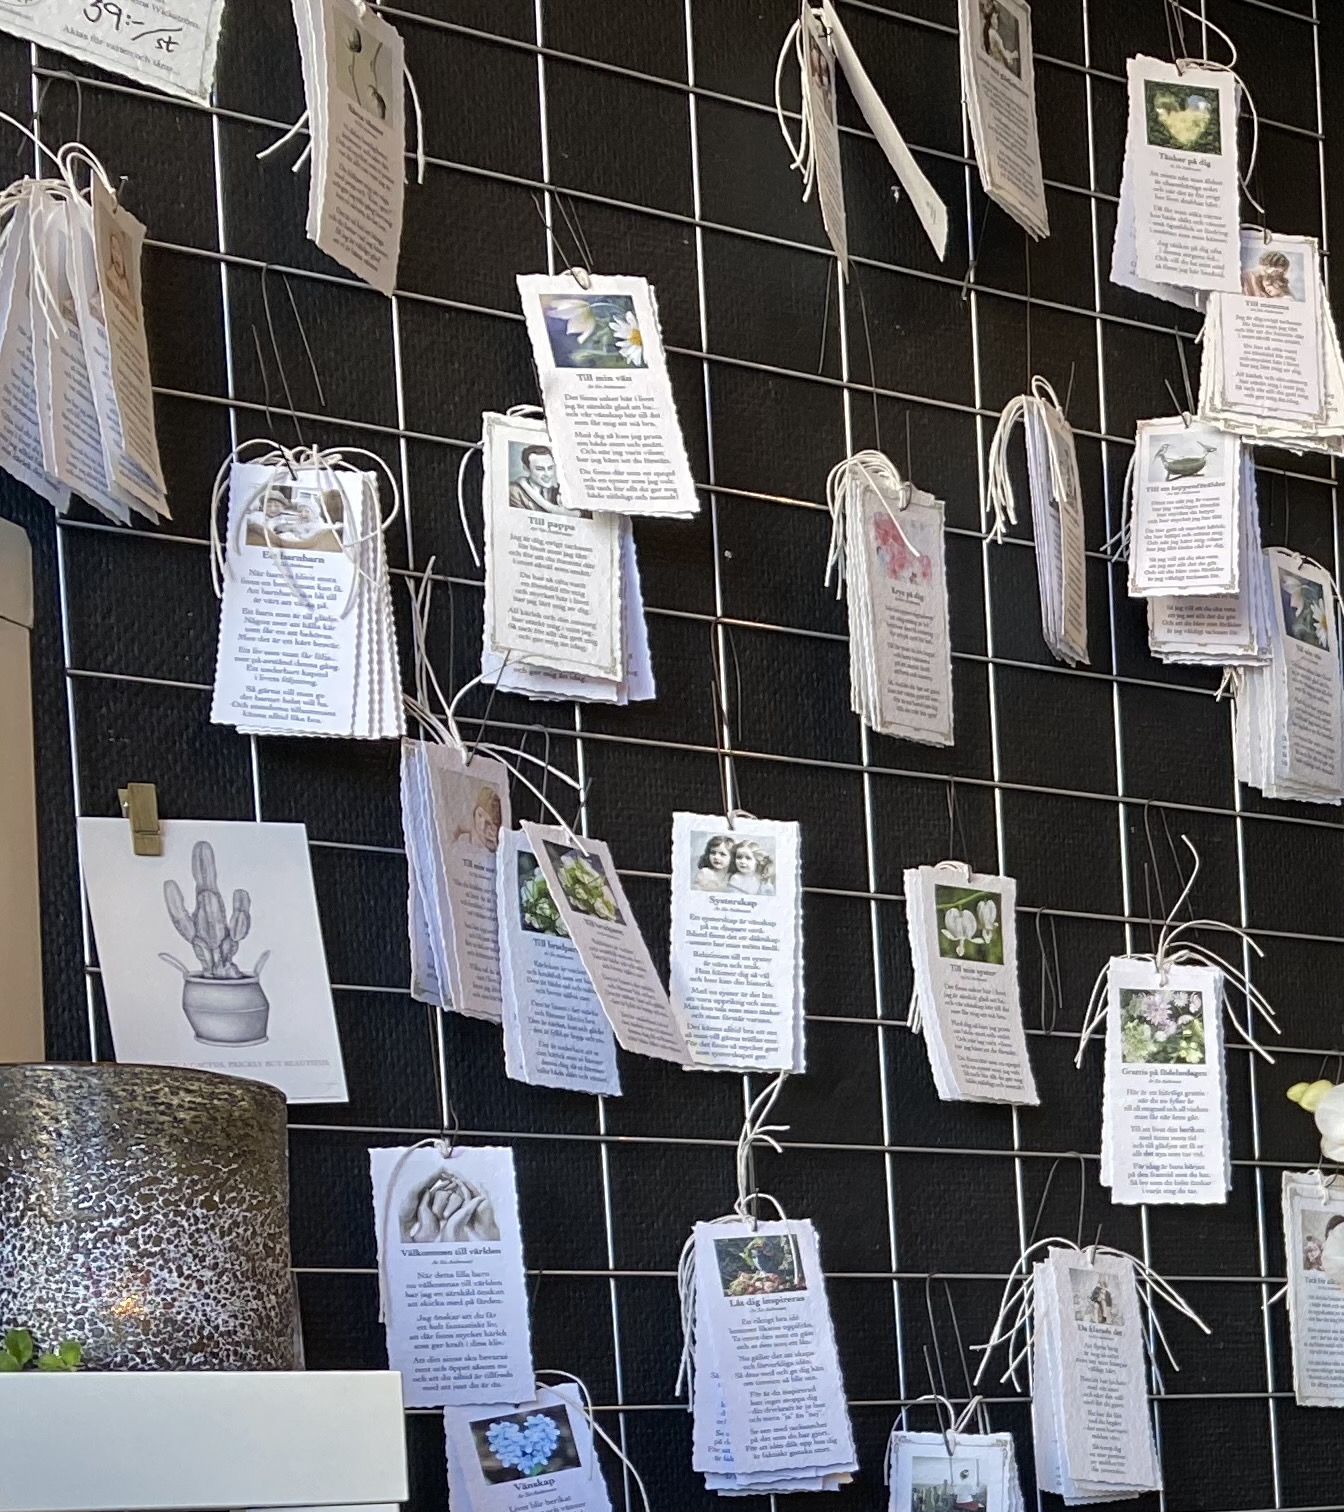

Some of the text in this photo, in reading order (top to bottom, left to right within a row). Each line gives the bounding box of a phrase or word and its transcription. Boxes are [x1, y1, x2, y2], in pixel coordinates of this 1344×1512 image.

[156, 36, 178, 52] st
[1159, 152, 1185, 162] Tänker
[1198, 159, 1210, 168] dig
[576, 373, 592, 381] Till
[527, 516, 575, 531] Till pappa
[891, 586, 923, 602] Krya på dig
[709, 896, 756, 908] Systerskap
[950, 964, 961, 972] Till
[1149, 1068, 1158, 1077] på
[401, 1248, 452, 1256] Välkommen
[454, 1247, 466, 1255] till
[729, 1296, 804, 1307] Låt dig inspireras
[1088, 1325, 1111, 1334] klarade
[1113, 1328, 1122, 1336] det
[513, 1478, 554, 1490] Vänskap
